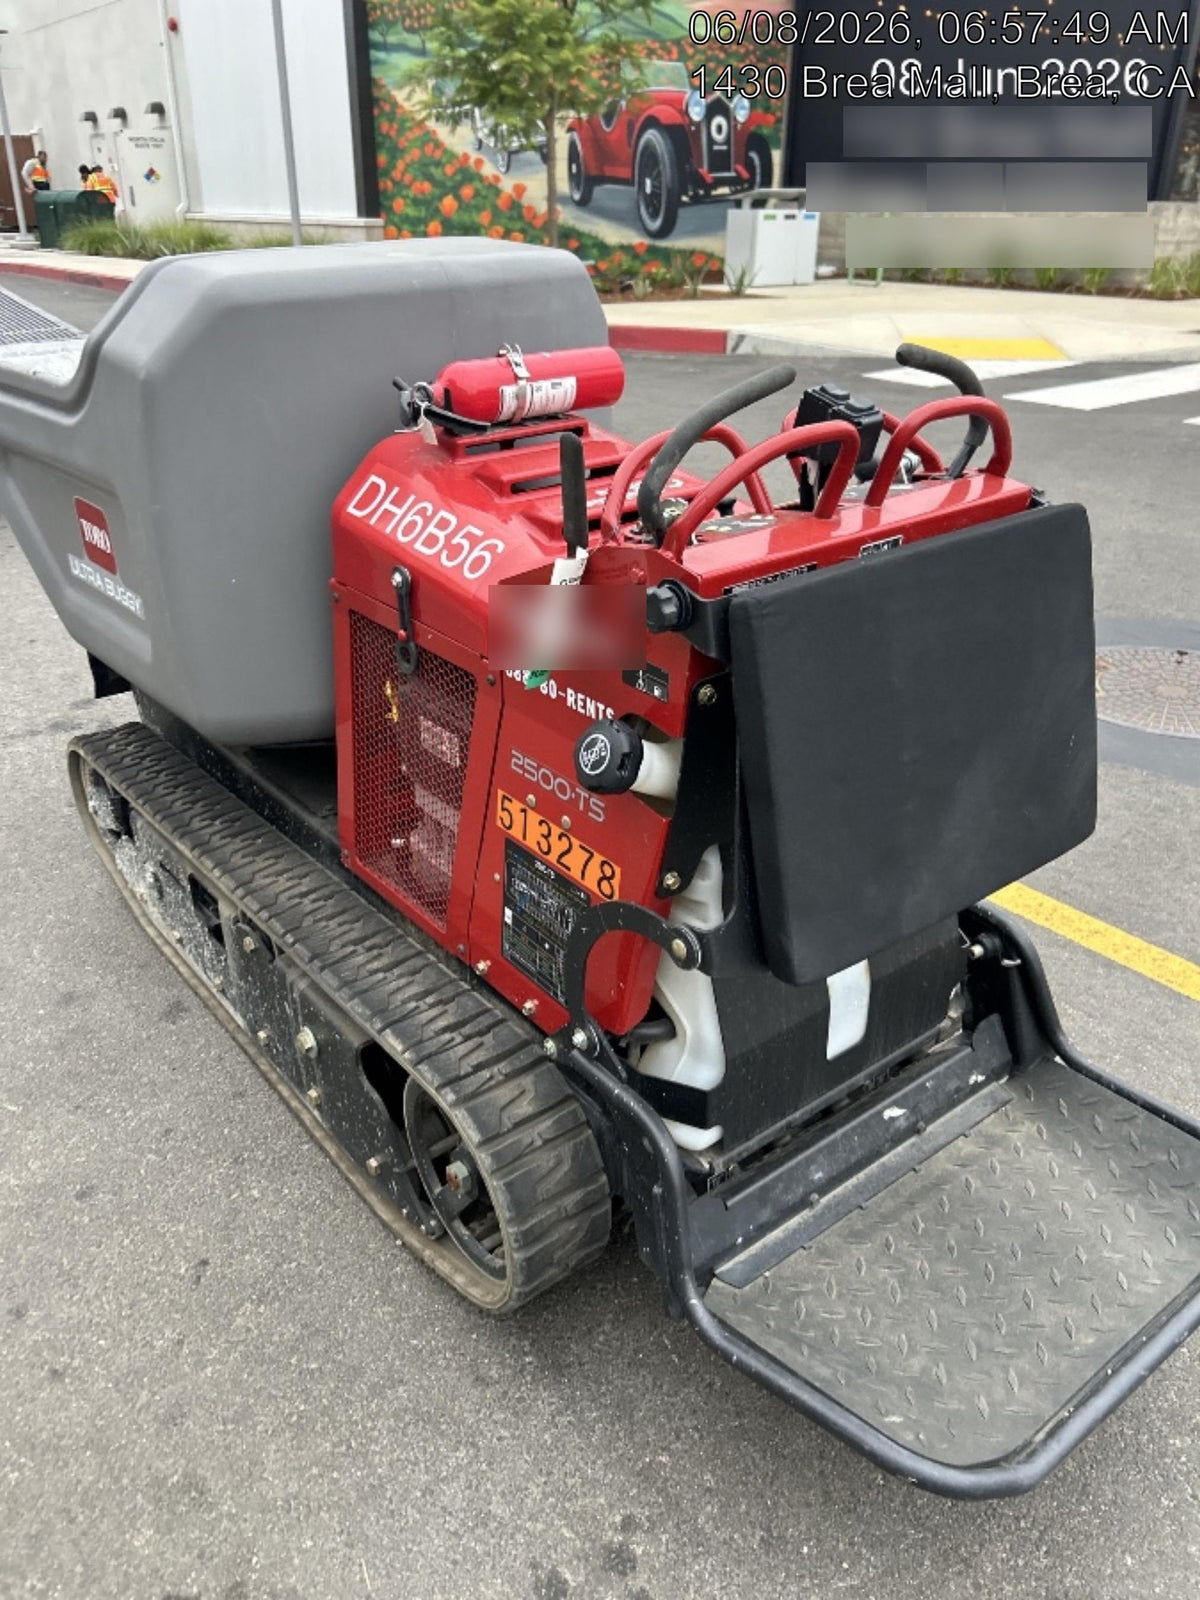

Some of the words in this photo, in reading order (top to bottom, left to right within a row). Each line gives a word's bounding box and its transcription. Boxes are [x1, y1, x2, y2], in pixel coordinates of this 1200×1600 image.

[80, 518, 111, 554] TORO
[346, 474, 506, 580] DH6B56
[68, 554, 106, 592] ULTRA
[104, 577, 146, 620] BUGGY
[499, 794, 617, 900] 513278
